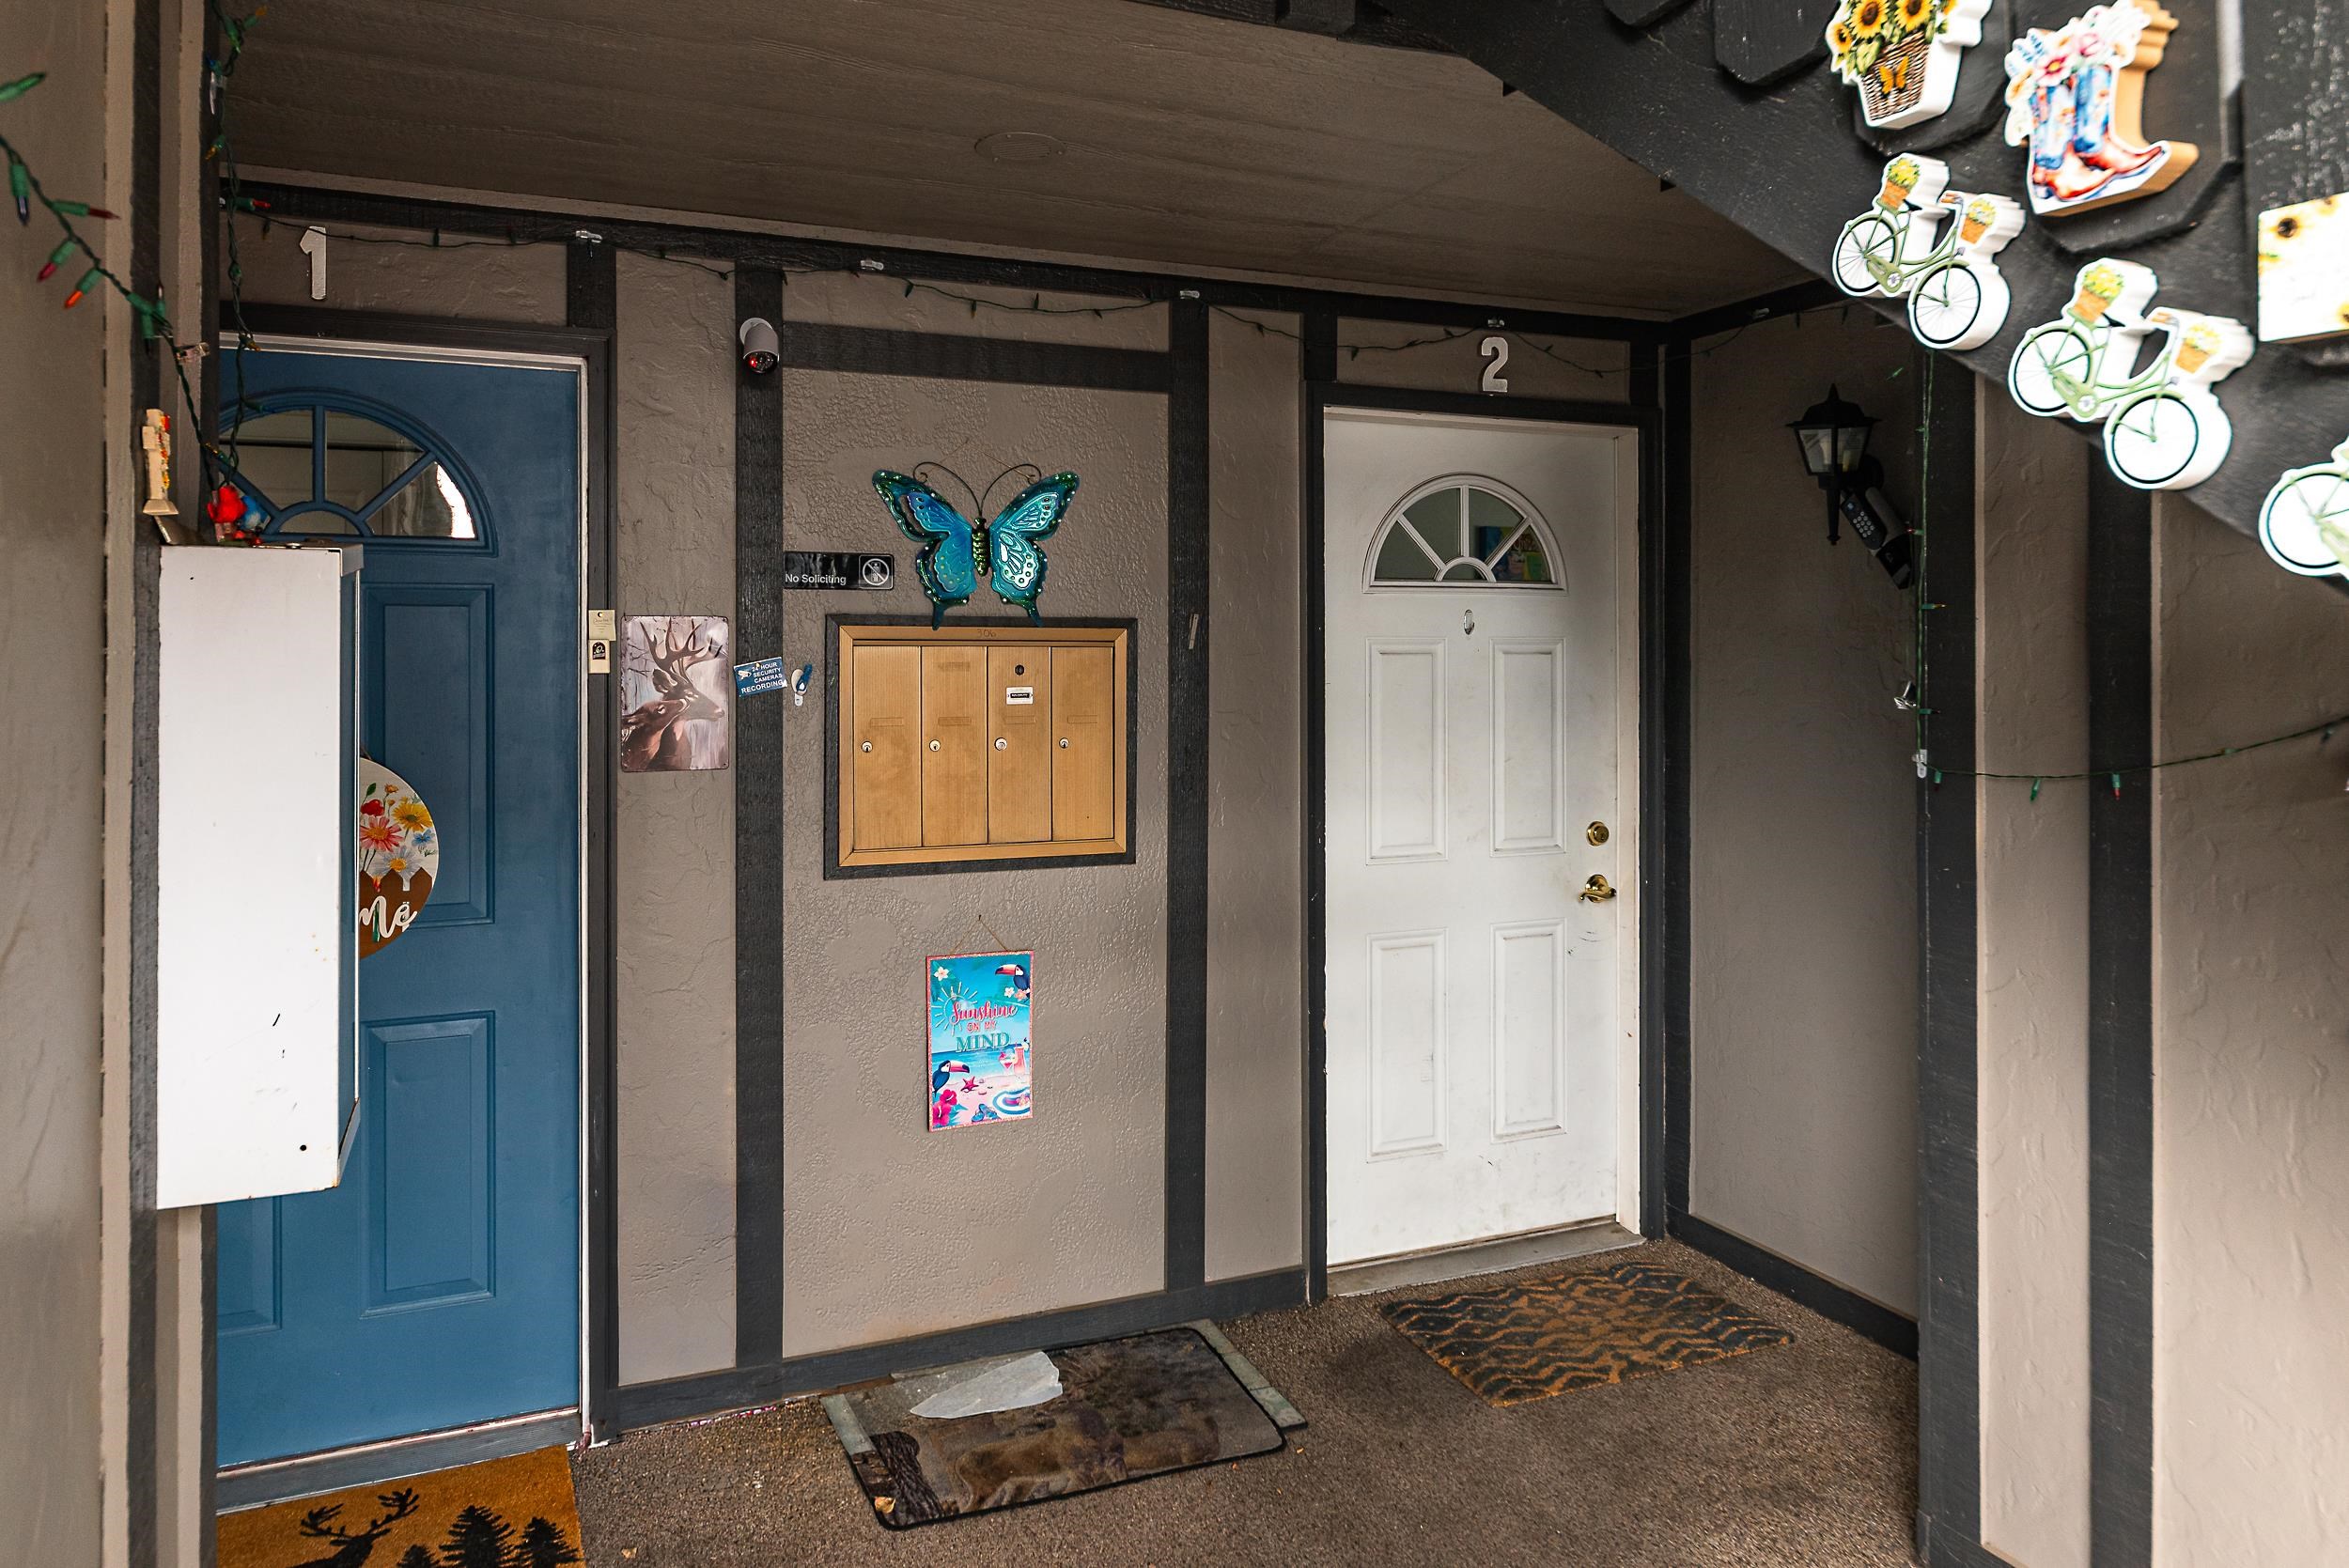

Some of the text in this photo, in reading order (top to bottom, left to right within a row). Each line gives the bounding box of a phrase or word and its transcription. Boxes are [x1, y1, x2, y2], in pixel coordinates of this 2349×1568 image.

[299, 225, 327, 301] 1
[1481, 336, 1509, 393] 2
[785, 573, 847, 586] No Soliciting
[753, 667, 781, 678] SECURITY
[760, 661, 778, 670] HOUR
[754, 673, 783, 684] CAMERAS
[740, 679, 784, 694] RECORDING
[949, 1000, 1019, 1025] Sunshine
[967, 1019, 997, 1032] ON MY
[956, 1032, 1011, 1052] MIND
